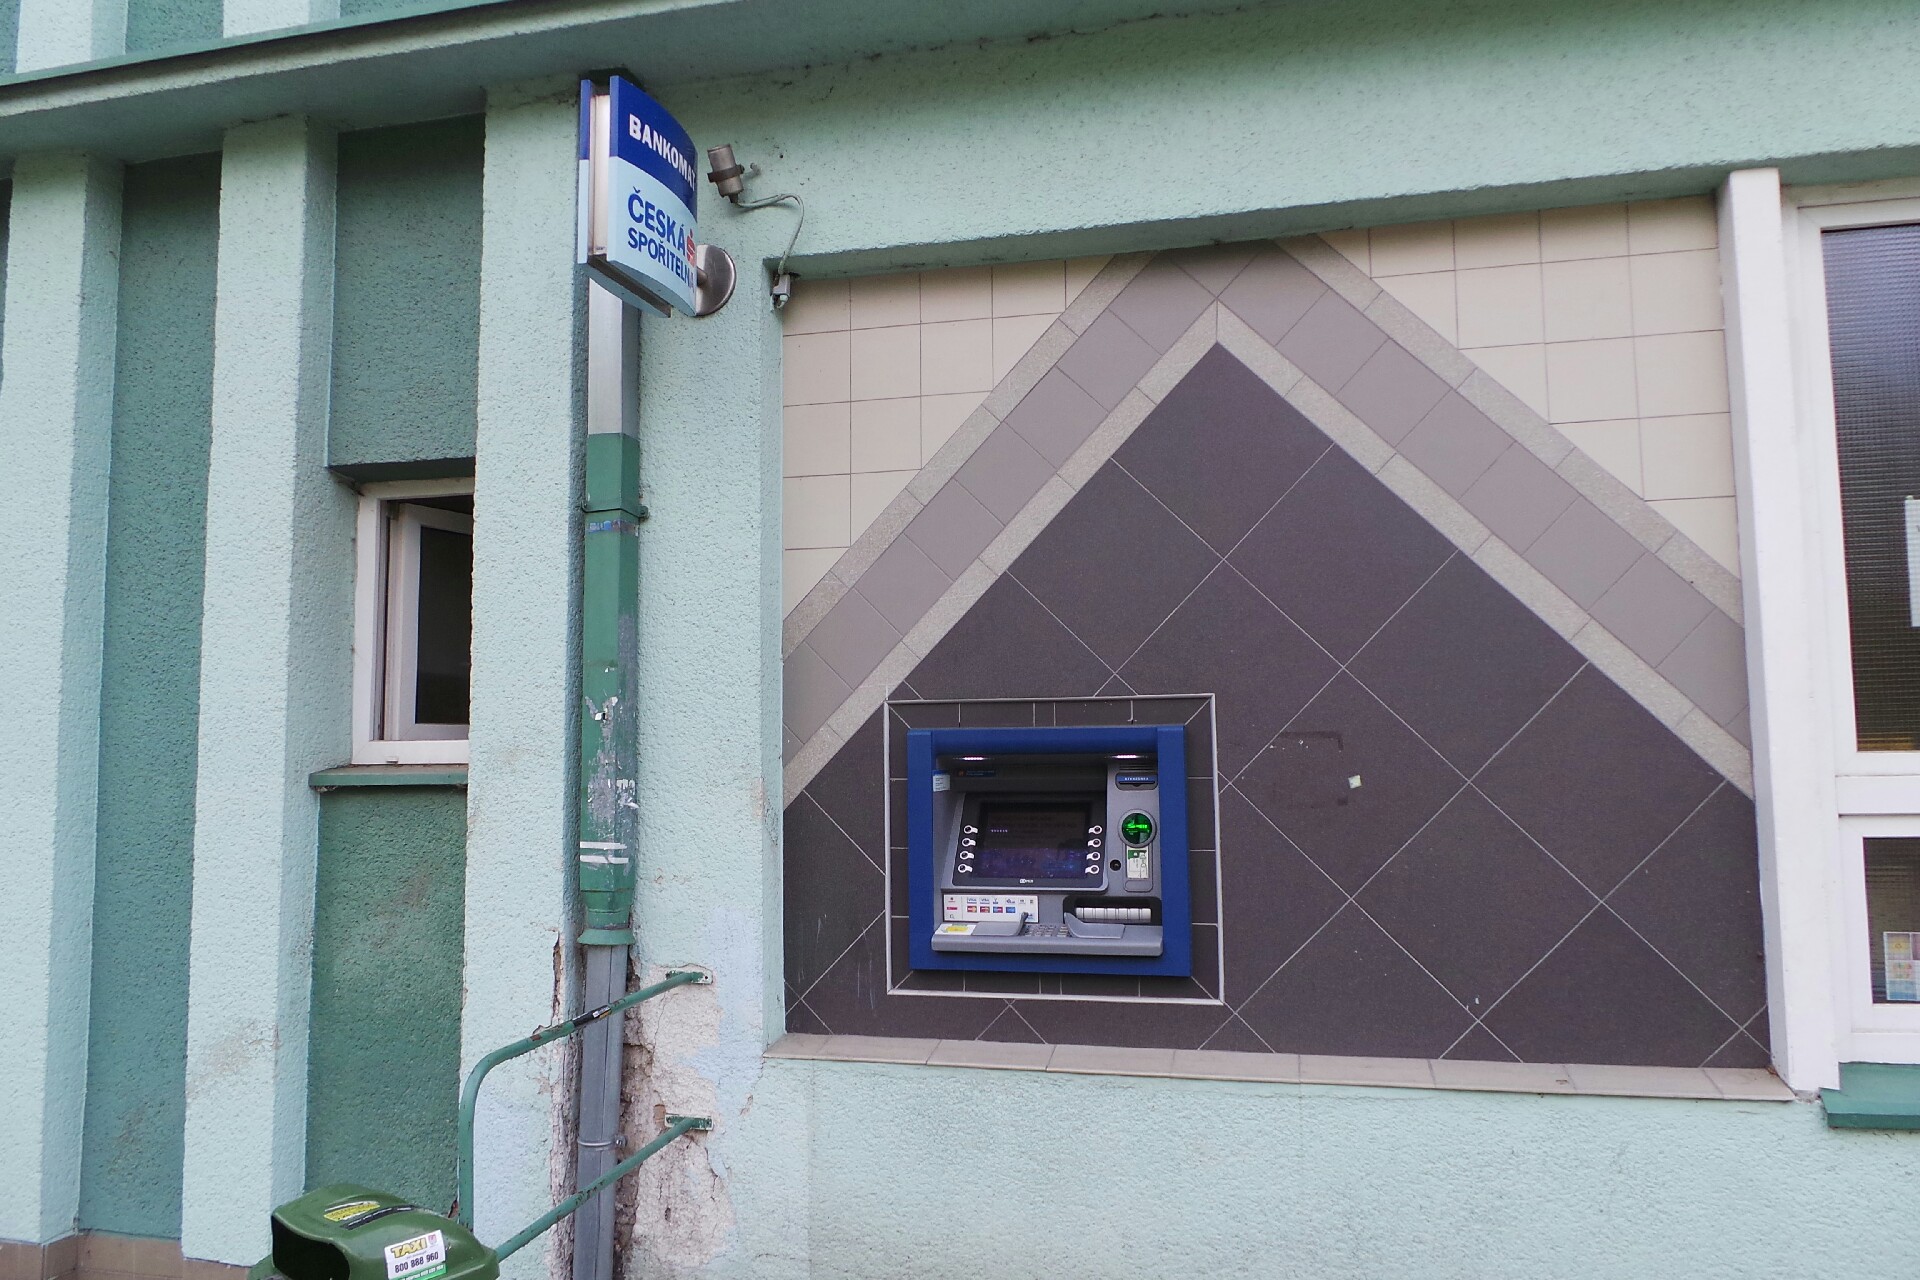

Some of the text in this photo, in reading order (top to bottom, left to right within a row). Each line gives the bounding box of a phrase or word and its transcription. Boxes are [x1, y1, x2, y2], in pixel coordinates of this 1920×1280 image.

[628, 113, 695, 191] BANKOMAT
[627, 186, 686, 256] ČESKÁ
[391, 1238, 427, 1258] TAXI
[394, 1261, 409, 1273] 800
[410, 1256, 424, 1268] 888
[426, 1251, 439, 1262] 960
